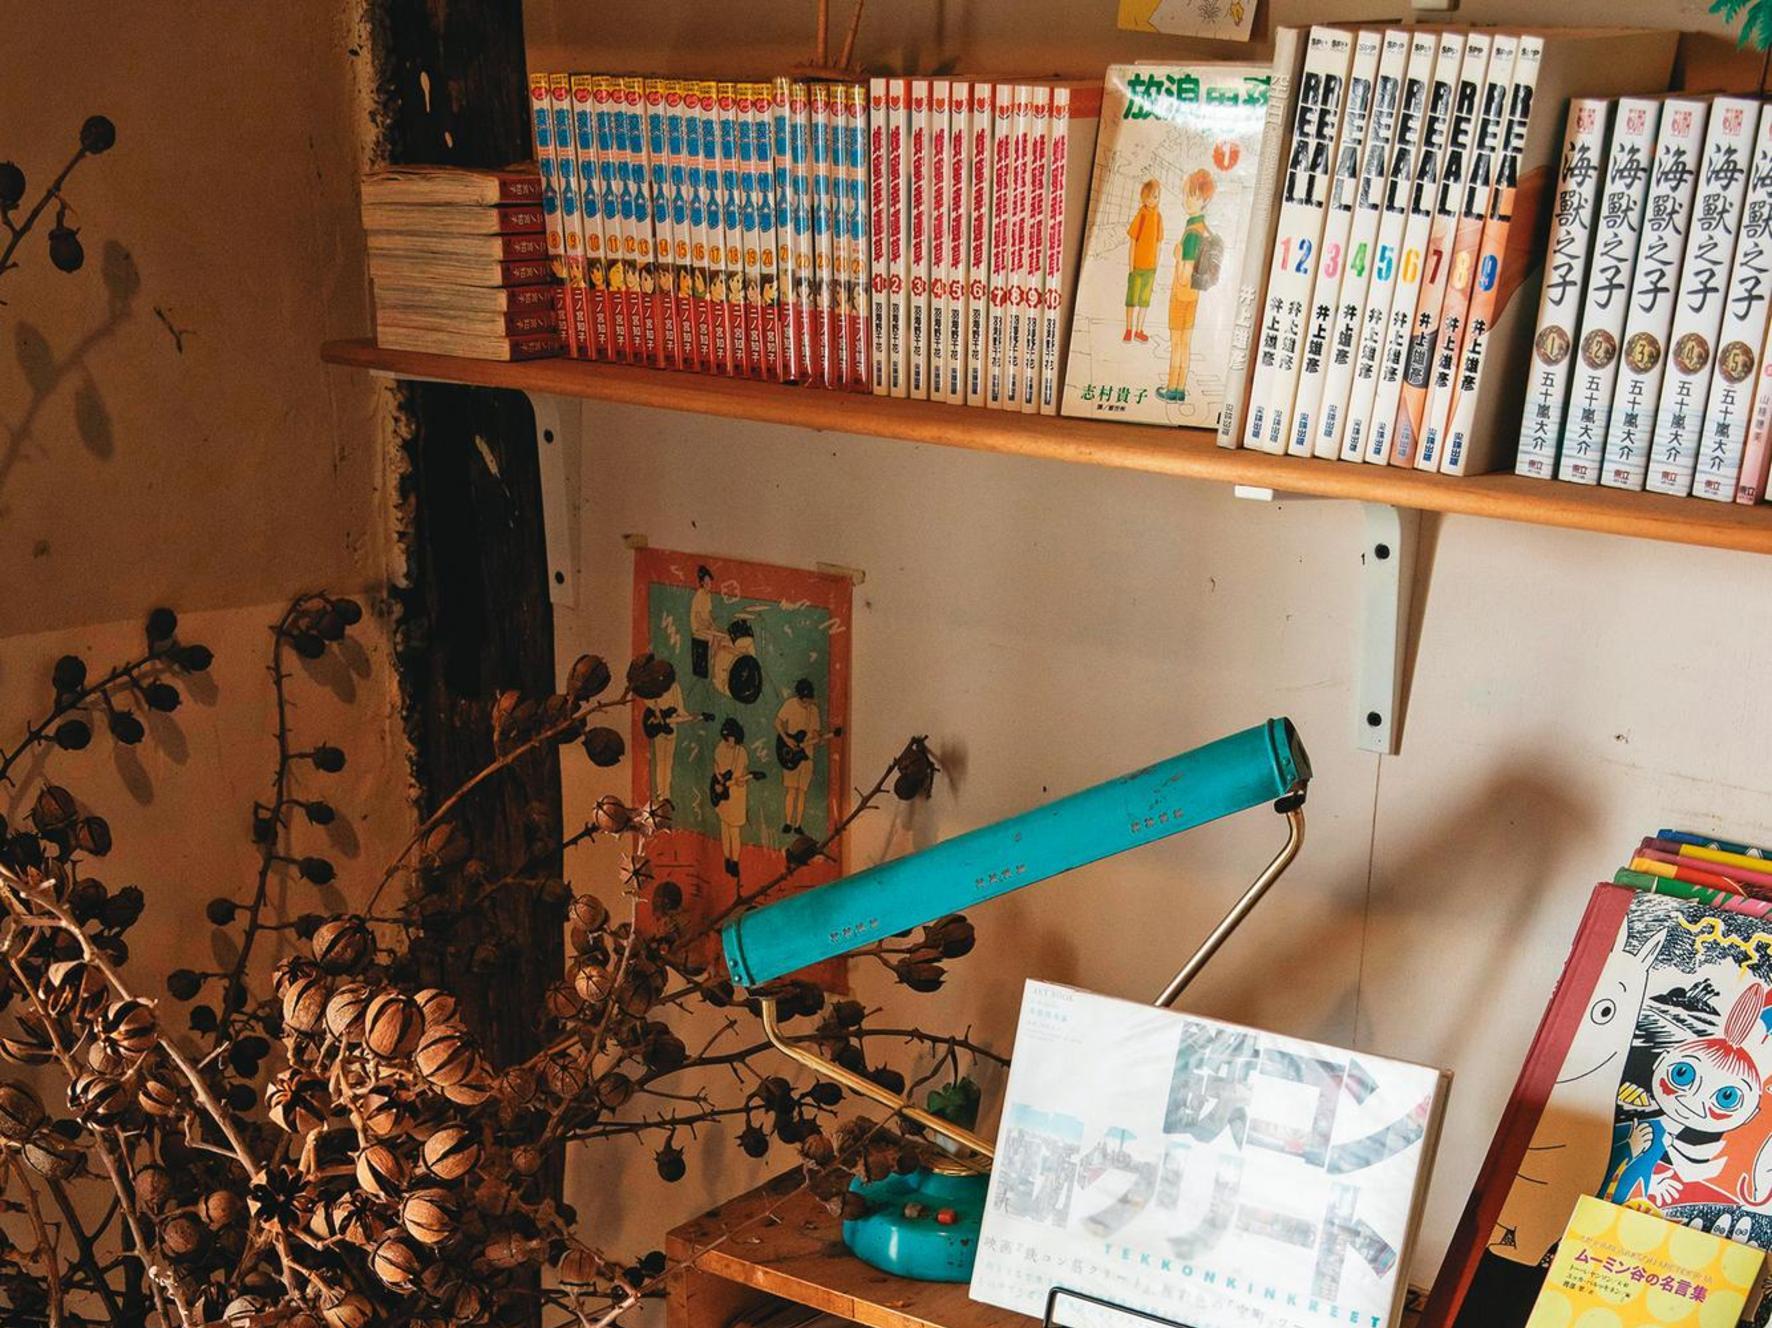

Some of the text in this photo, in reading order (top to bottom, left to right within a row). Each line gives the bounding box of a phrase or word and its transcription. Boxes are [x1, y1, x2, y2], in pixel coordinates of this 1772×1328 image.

[1386, 78, 1425, 215] REAL
[1411, 80, 1452, 217] REAL
[1437, 80, 1477, 218] REAL
[1463, 82, 1506, 221] REAL
[1490, 83, 1534, 222] REAL
[1280, 237, 1291, 271] 1
[1295, 238, 1312, 274] 2
[1324, 242, 1341, 279] 3
[1351, 242, 1368, 277] 4
[1376, 245, 1394, 281] 5
[1547, 140, 1597, 307] 海獸之子
[1593, 142, 1647, 310] 海獸之子
[1638, 144, 1694, 313] 海獸之子
[1686, 142, 1745, 313] 海獸之子
[1402, 248, 1420, 284] 6
[1428, 249, 1443, 285] 7
[1454, 251, 1471, 290] 8
[1478, 254, 1498, 292] 9
[1081, 384, 1148, 404] 志村貴子
[1533, 371, 1557, 451] 五十嵐大介
[1577, 375, 1602, 456] 五十嵐大介
[1619, 379, 1645, 460] 五十嵐大介
[1666, 380, 1693, 461] 五十嵐大介
[1709, 388, 1737, 471] 五十嵐大介
[1574, 1247, 1709, 1303] ムーミン谷の名言集
